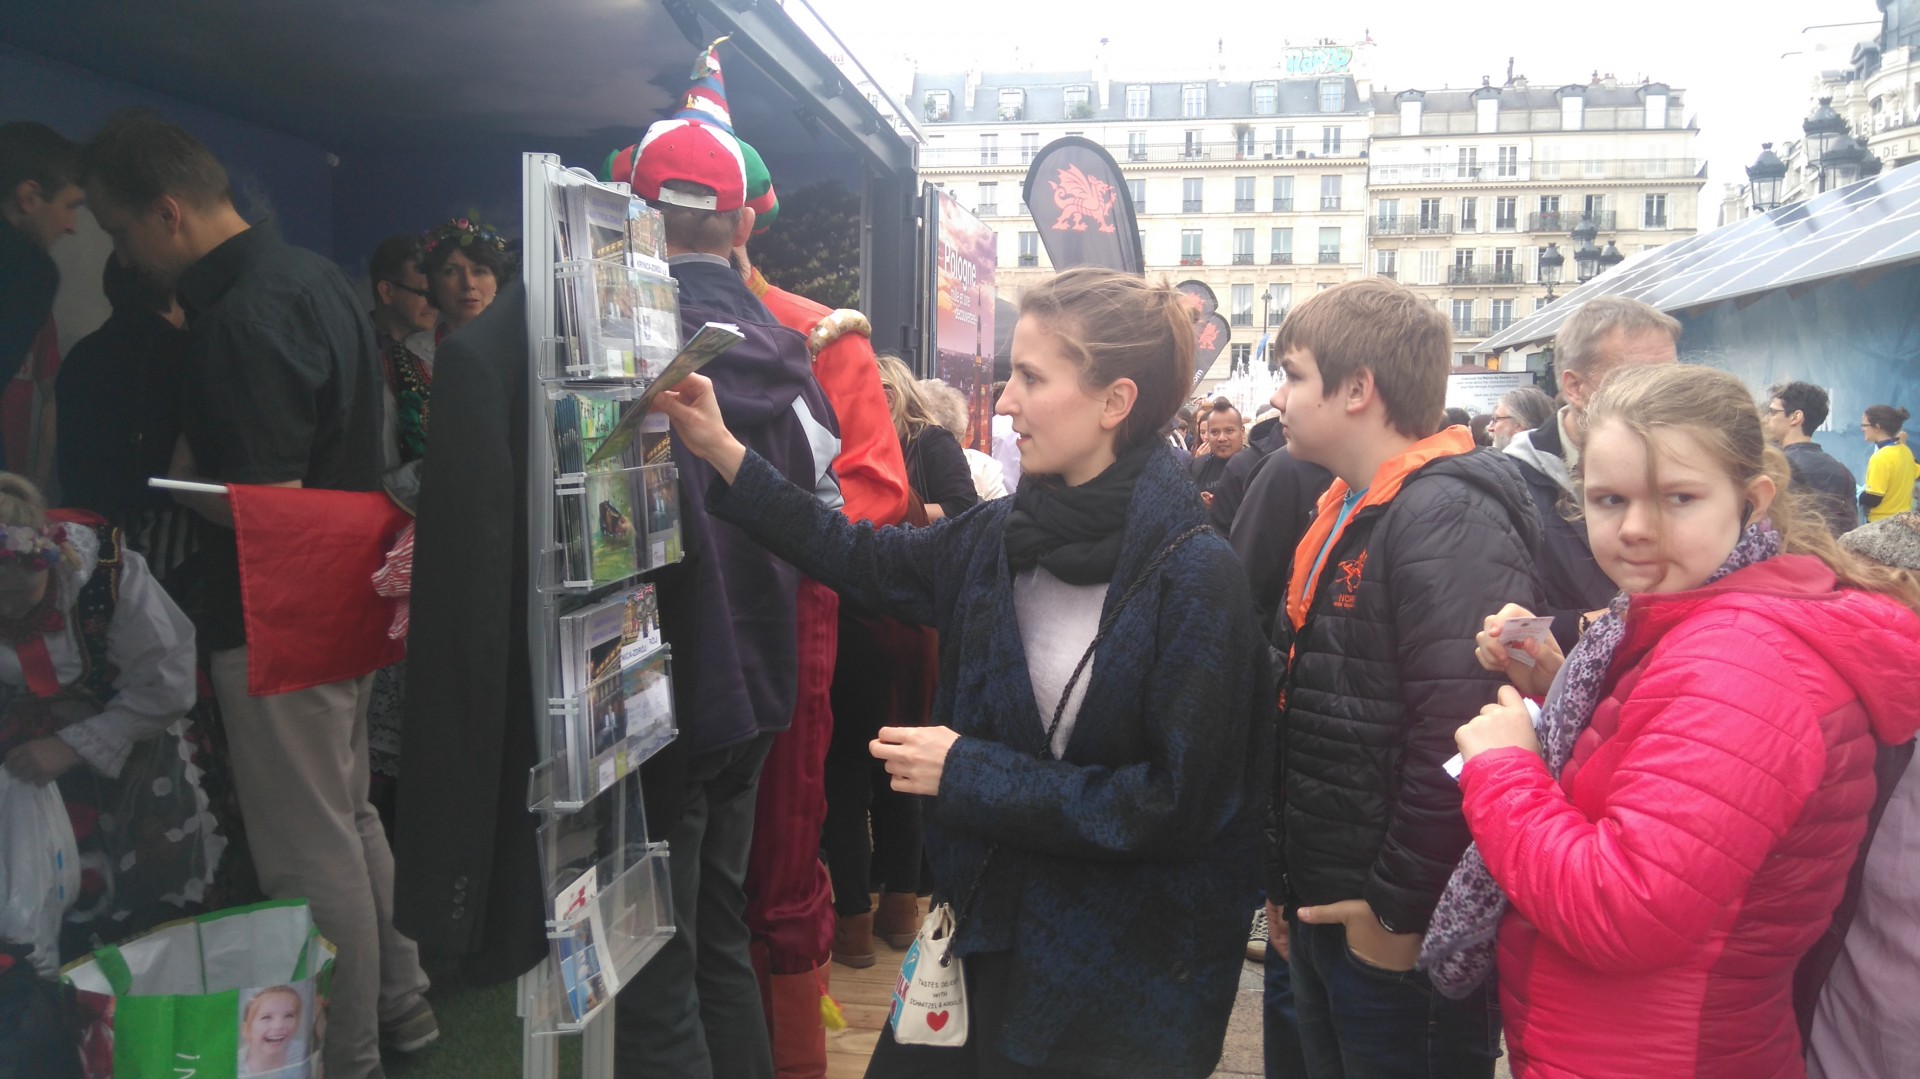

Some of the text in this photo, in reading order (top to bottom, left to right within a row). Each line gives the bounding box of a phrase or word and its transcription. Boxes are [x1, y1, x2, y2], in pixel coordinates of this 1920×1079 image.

[1883, 144, 1898, 158] DE
[944, 242, 977, 292] Pologne
[918, 978, 939, 989] TASTES
[909, 998, 938, 1010] SCHNITZEL
